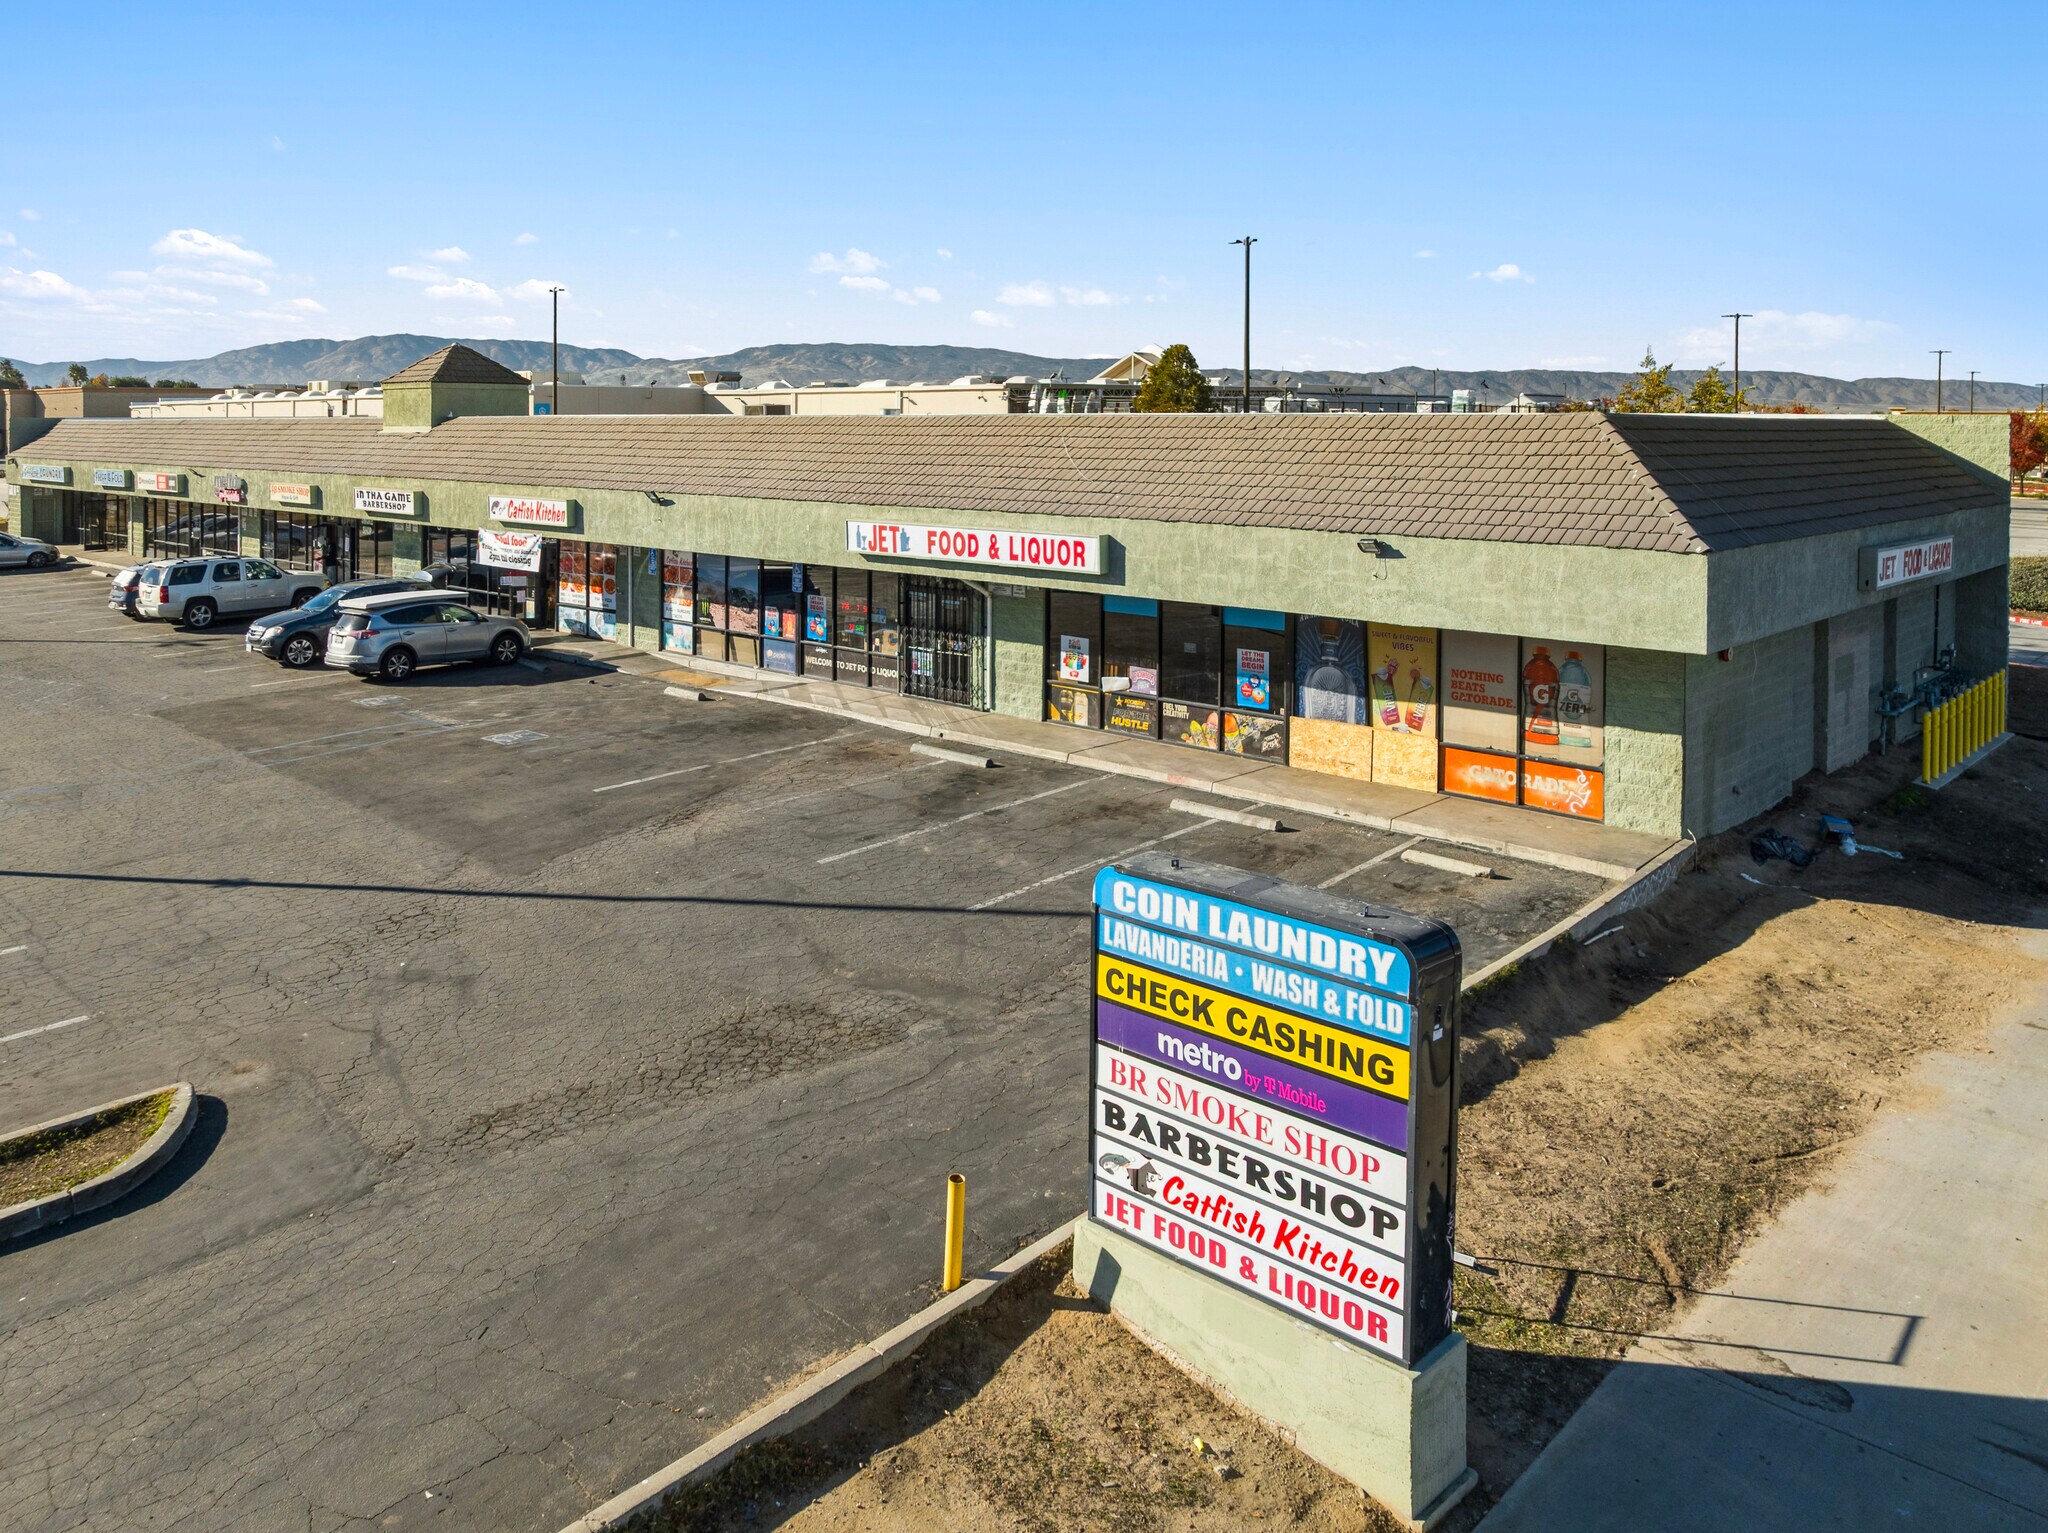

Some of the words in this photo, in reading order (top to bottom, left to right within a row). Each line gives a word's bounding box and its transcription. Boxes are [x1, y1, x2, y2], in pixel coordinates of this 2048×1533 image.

[278, 486, 295, 495] SMOKE
[297, 487, 309, 496] SHOP
[366, 491, 382, 500] THA
[363, 500, 406, 511] BARBERSHOP
[507, 499, 534, 521] Catfish
[535, 501, 566, 522] Kitchen
[868, 525, 900, 553] JET
[927, 530, 979, 558] FOOD
[989, 534, 1000, 559] &
[1009, 536, 1086, 567] LIQUOR
[509, 555, 532, 567] closing
[1879, 555, 1896, 582] JET
[1903, 548, 1922, 577] FOOD
[1924, 551, 1927, 567] &
[1928, 542, 1952, 572] LIQUOR
[1372, 630, 1391, 639] SWEET
[1399, 634, 1434, 645] FLAVORFUL
[1392, 641, 1414, 652] VIBES
[806, 655, 832, 668] WELCOM
[837, 661, 845, 669] TO
[845, 662, 857, 672] JET
[877, 667, 898, 678] LIQUO
[1242, 661, 1264, 670] BEGIN
[1451, 668, 1504, 684] NOTHING
[1451, 680, 1486, 693] BEATS
[1533, 684, 1549, 704] G
[1567, 689, 1578, 702] G
[1163, 702, 1175, 711] FUEL
[1175, 704, 1187, 712] YOUR
[1451, 691, 1517, 709] GATORADE.
[1111, 716, 1149, 730] HUSTLE
[1113, 708, 1130, 718] FOR
[1130, 710, 1149, 720] THE
[1163, 709, 1190, 720] CREATIVITY
[1469, 765, 1569, 795] GATORADE
[1113, 880, 1199, 933] COIN
[1208, 905, 1397, 986] LAUNDRY
[1103, 918, 1229, 984] LAVANDERIA
[1251, 962, 1318, 1010] WASH
[1323, 990, 1341, 1017] &
[1346, 990, 1404, 1035] FOLD
[1105, 967, 1216, 1028] CHECK
[1226, 1007, 1395, 1086] CASHING
[1157, 1032, 1242, 1081] metro
[1244, 1069, 1261, 1093] by
[1277, 1080, 1327, 1114] Mobile
[1109, 1057, 1149, 1097] BR
[1156, 1077, 1273, 1146] SMOKE
[1284, 1125, 1381, 1185] SHOP
[1102, 1099, 1399, 1240] BARBERSHOP
[1162, 1175, 1266, 1244] Catfish
[1273, 1218, 1400, 1300] Kitchen
[1104, 1192, 1146, 1231] JET
[1153, 1213, 1227, 1269] FOOD
[1239, 1256, 1259, 1285] &
[1268, 1265, 1389, 1344] LIQUOR
